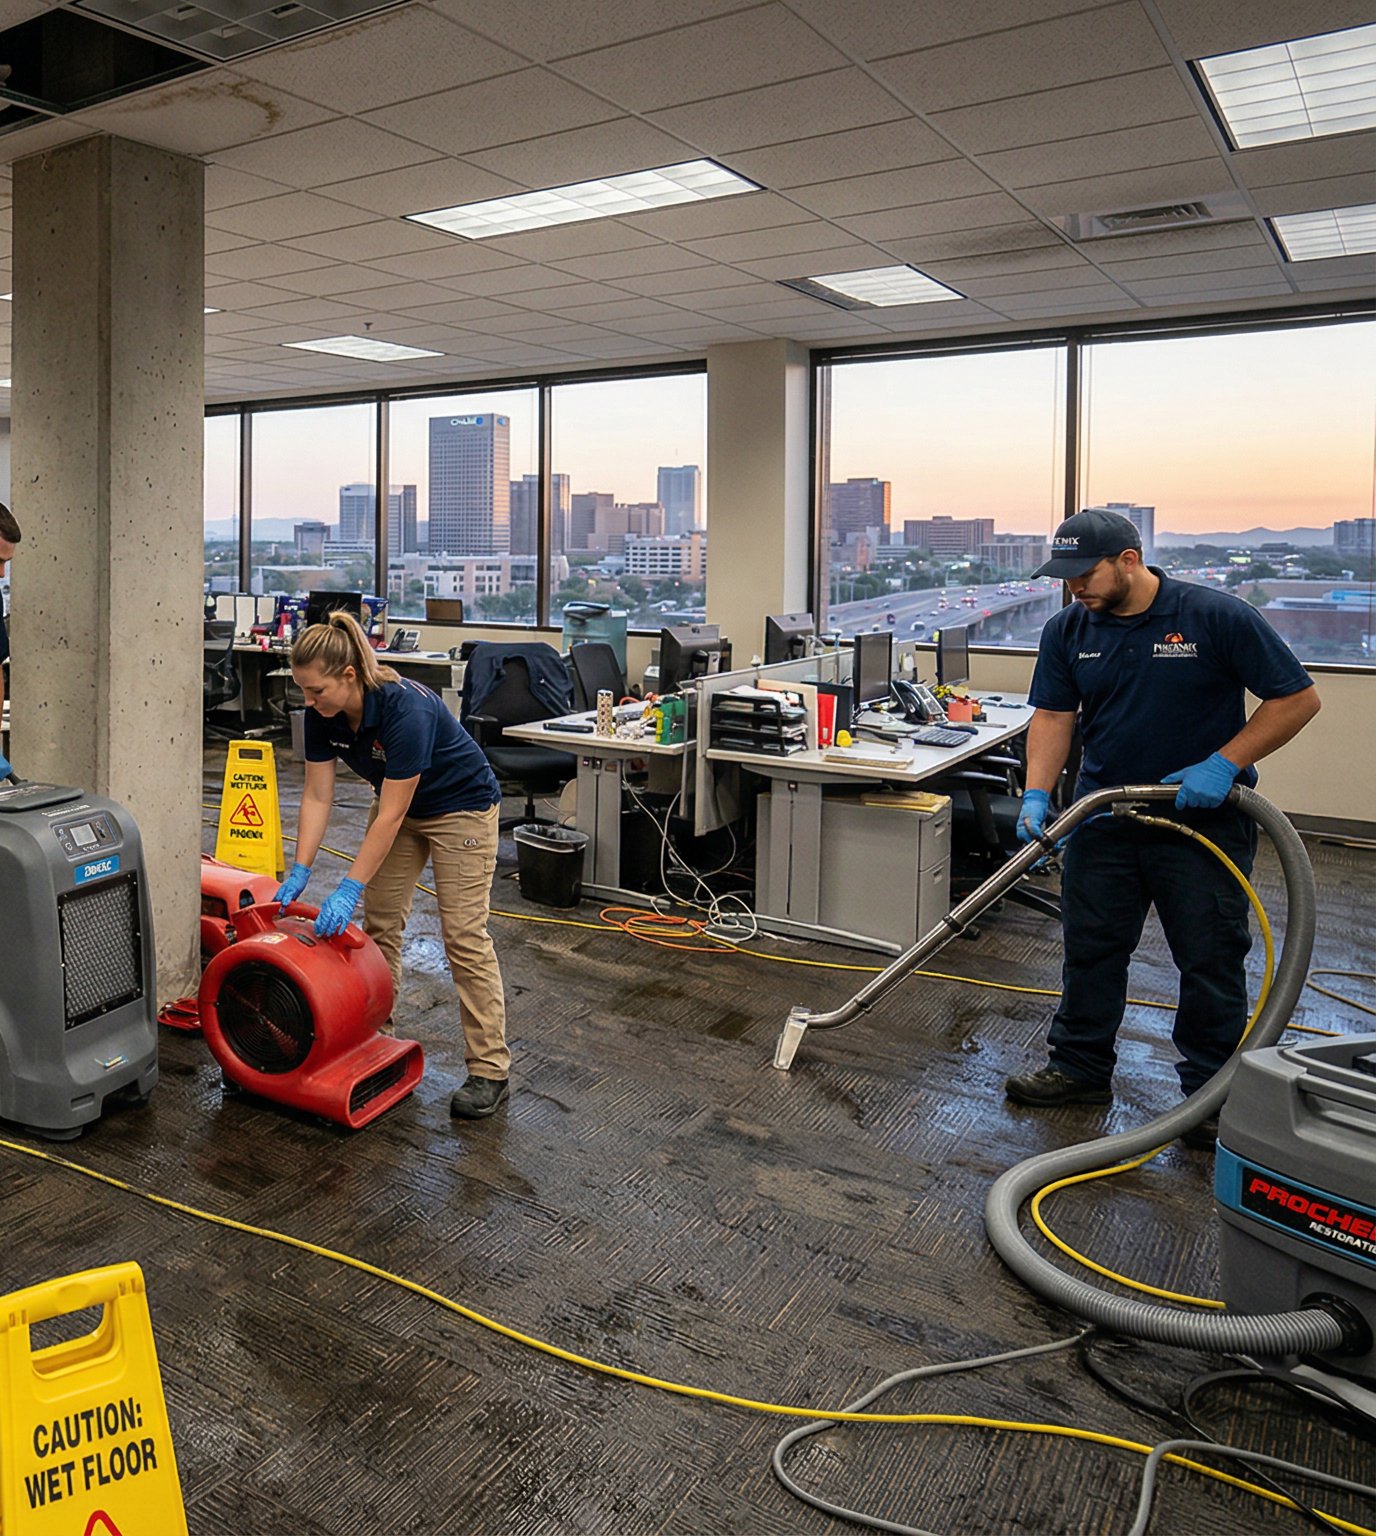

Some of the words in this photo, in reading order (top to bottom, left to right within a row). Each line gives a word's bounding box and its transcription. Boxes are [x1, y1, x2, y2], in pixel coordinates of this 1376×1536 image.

[1248, 1177, 1376, 1242] PROCHE
[33, 1397, 143, 1459] CAUTION:
[24, 1461, 75, 1509] WET
[82, 1437, 158, 1491] FLOOR
